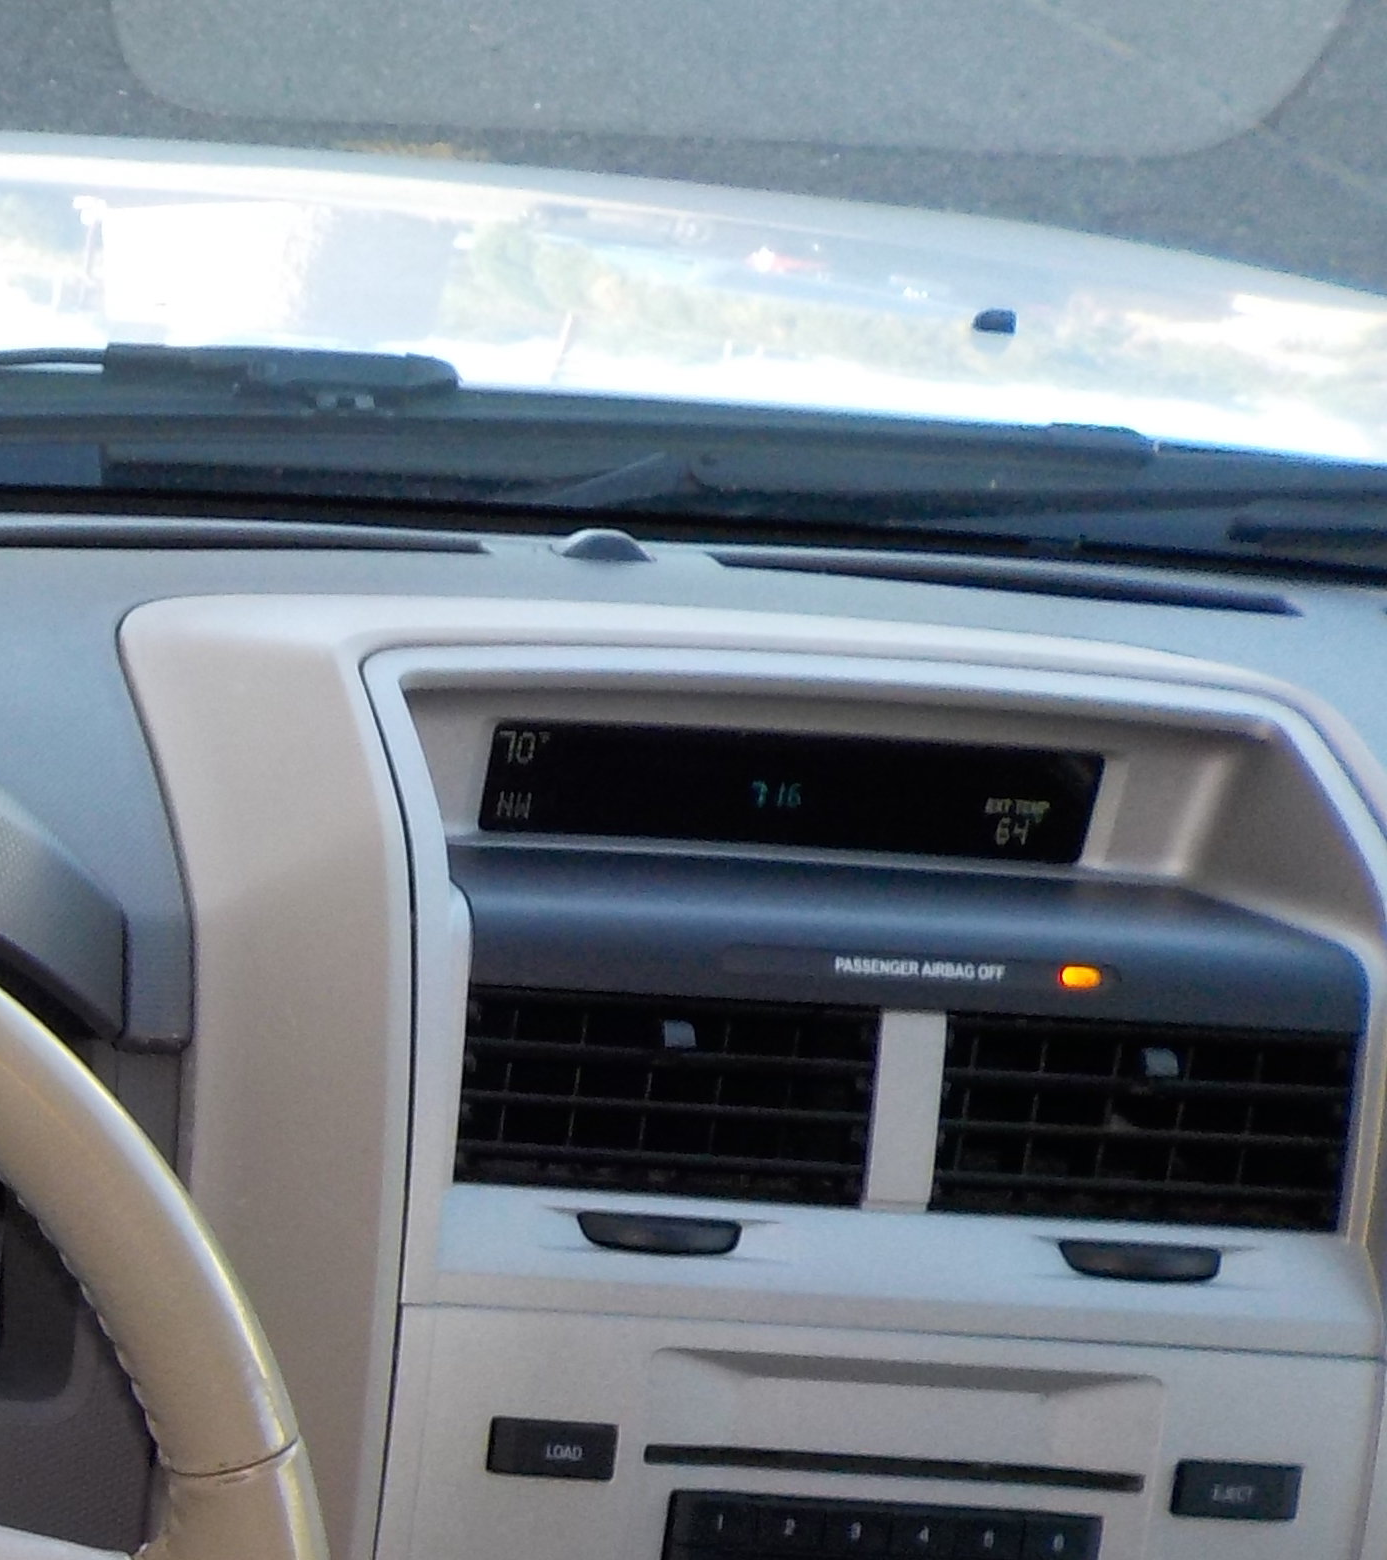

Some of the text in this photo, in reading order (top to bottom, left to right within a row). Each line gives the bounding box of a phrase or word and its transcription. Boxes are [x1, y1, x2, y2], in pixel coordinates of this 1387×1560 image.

[834, 955, 1006, 982] PASSENGER AIRBAG OFF
[545, 1443, 583, 1461] LOAD
